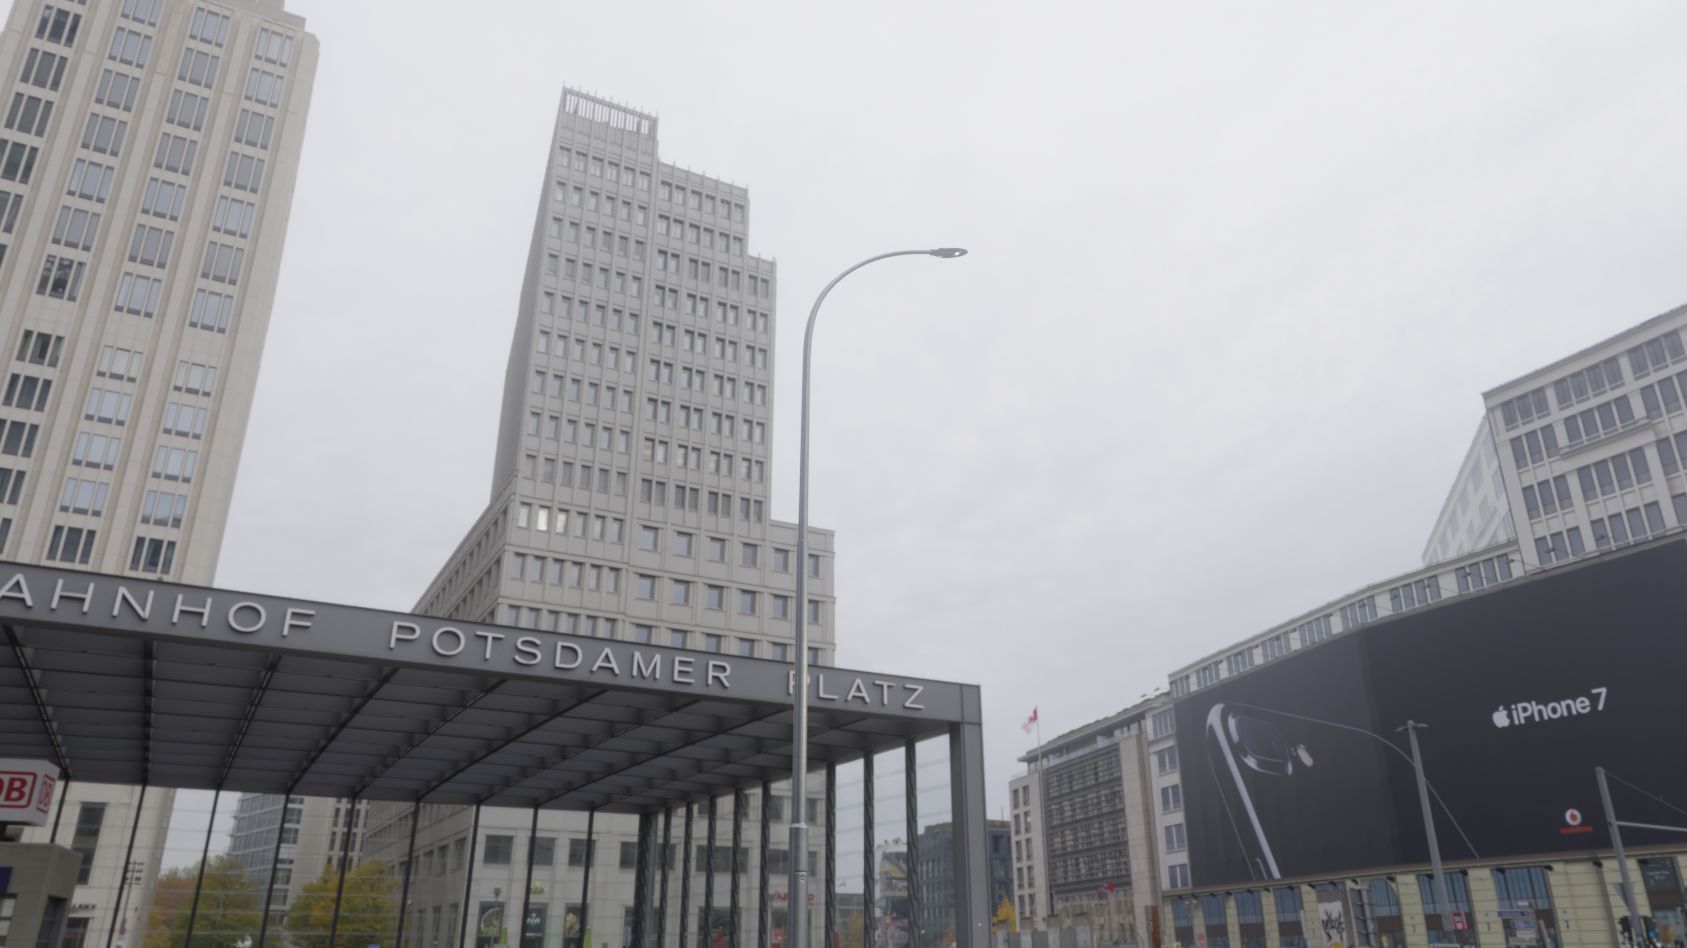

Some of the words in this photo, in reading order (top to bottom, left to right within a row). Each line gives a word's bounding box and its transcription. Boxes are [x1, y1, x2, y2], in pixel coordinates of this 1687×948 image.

[0, 573, 317, 638] AHNHOF
[388, 620, 733, 689] POTSDAMER
[1510, 696, 1591, 725] iPhone
[1590, 686, 1608, 712] 7
[0, 777, 29, 803] B
